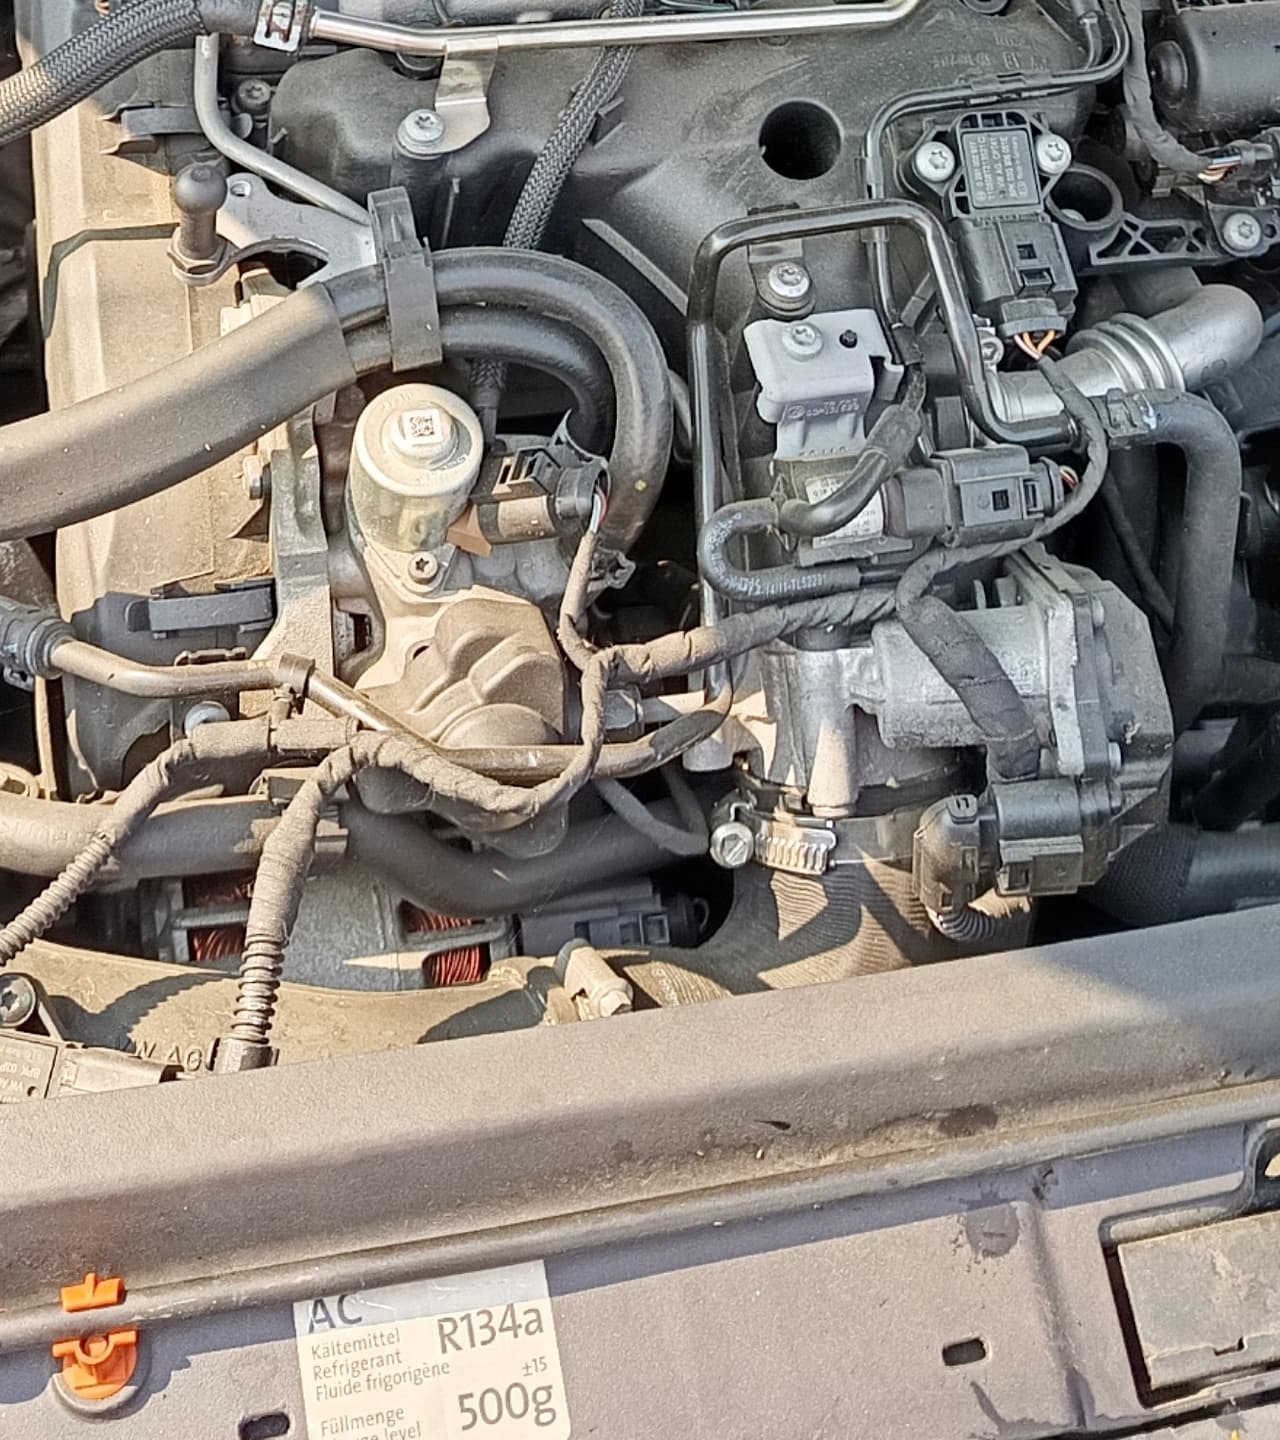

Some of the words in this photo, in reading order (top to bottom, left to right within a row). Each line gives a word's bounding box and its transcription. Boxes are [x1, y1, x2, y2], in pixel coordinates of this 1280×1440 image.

[308, 1294, 363, 1333] AC
[437, 1303, 545, 1355] R134a
[311, 1329, 401, 1361] Kältemittel
[313, 1350, 403, 1381] Refrigerant
[315, 1375, 363, 1402] Fluide
[365, 1361, 451, 1393] frigorigène
[521, 1356, 548, 1378] ±15
[320, 1407, 404, 1437] Füllmenge
[458, 1382, 557, 1431] 500g
